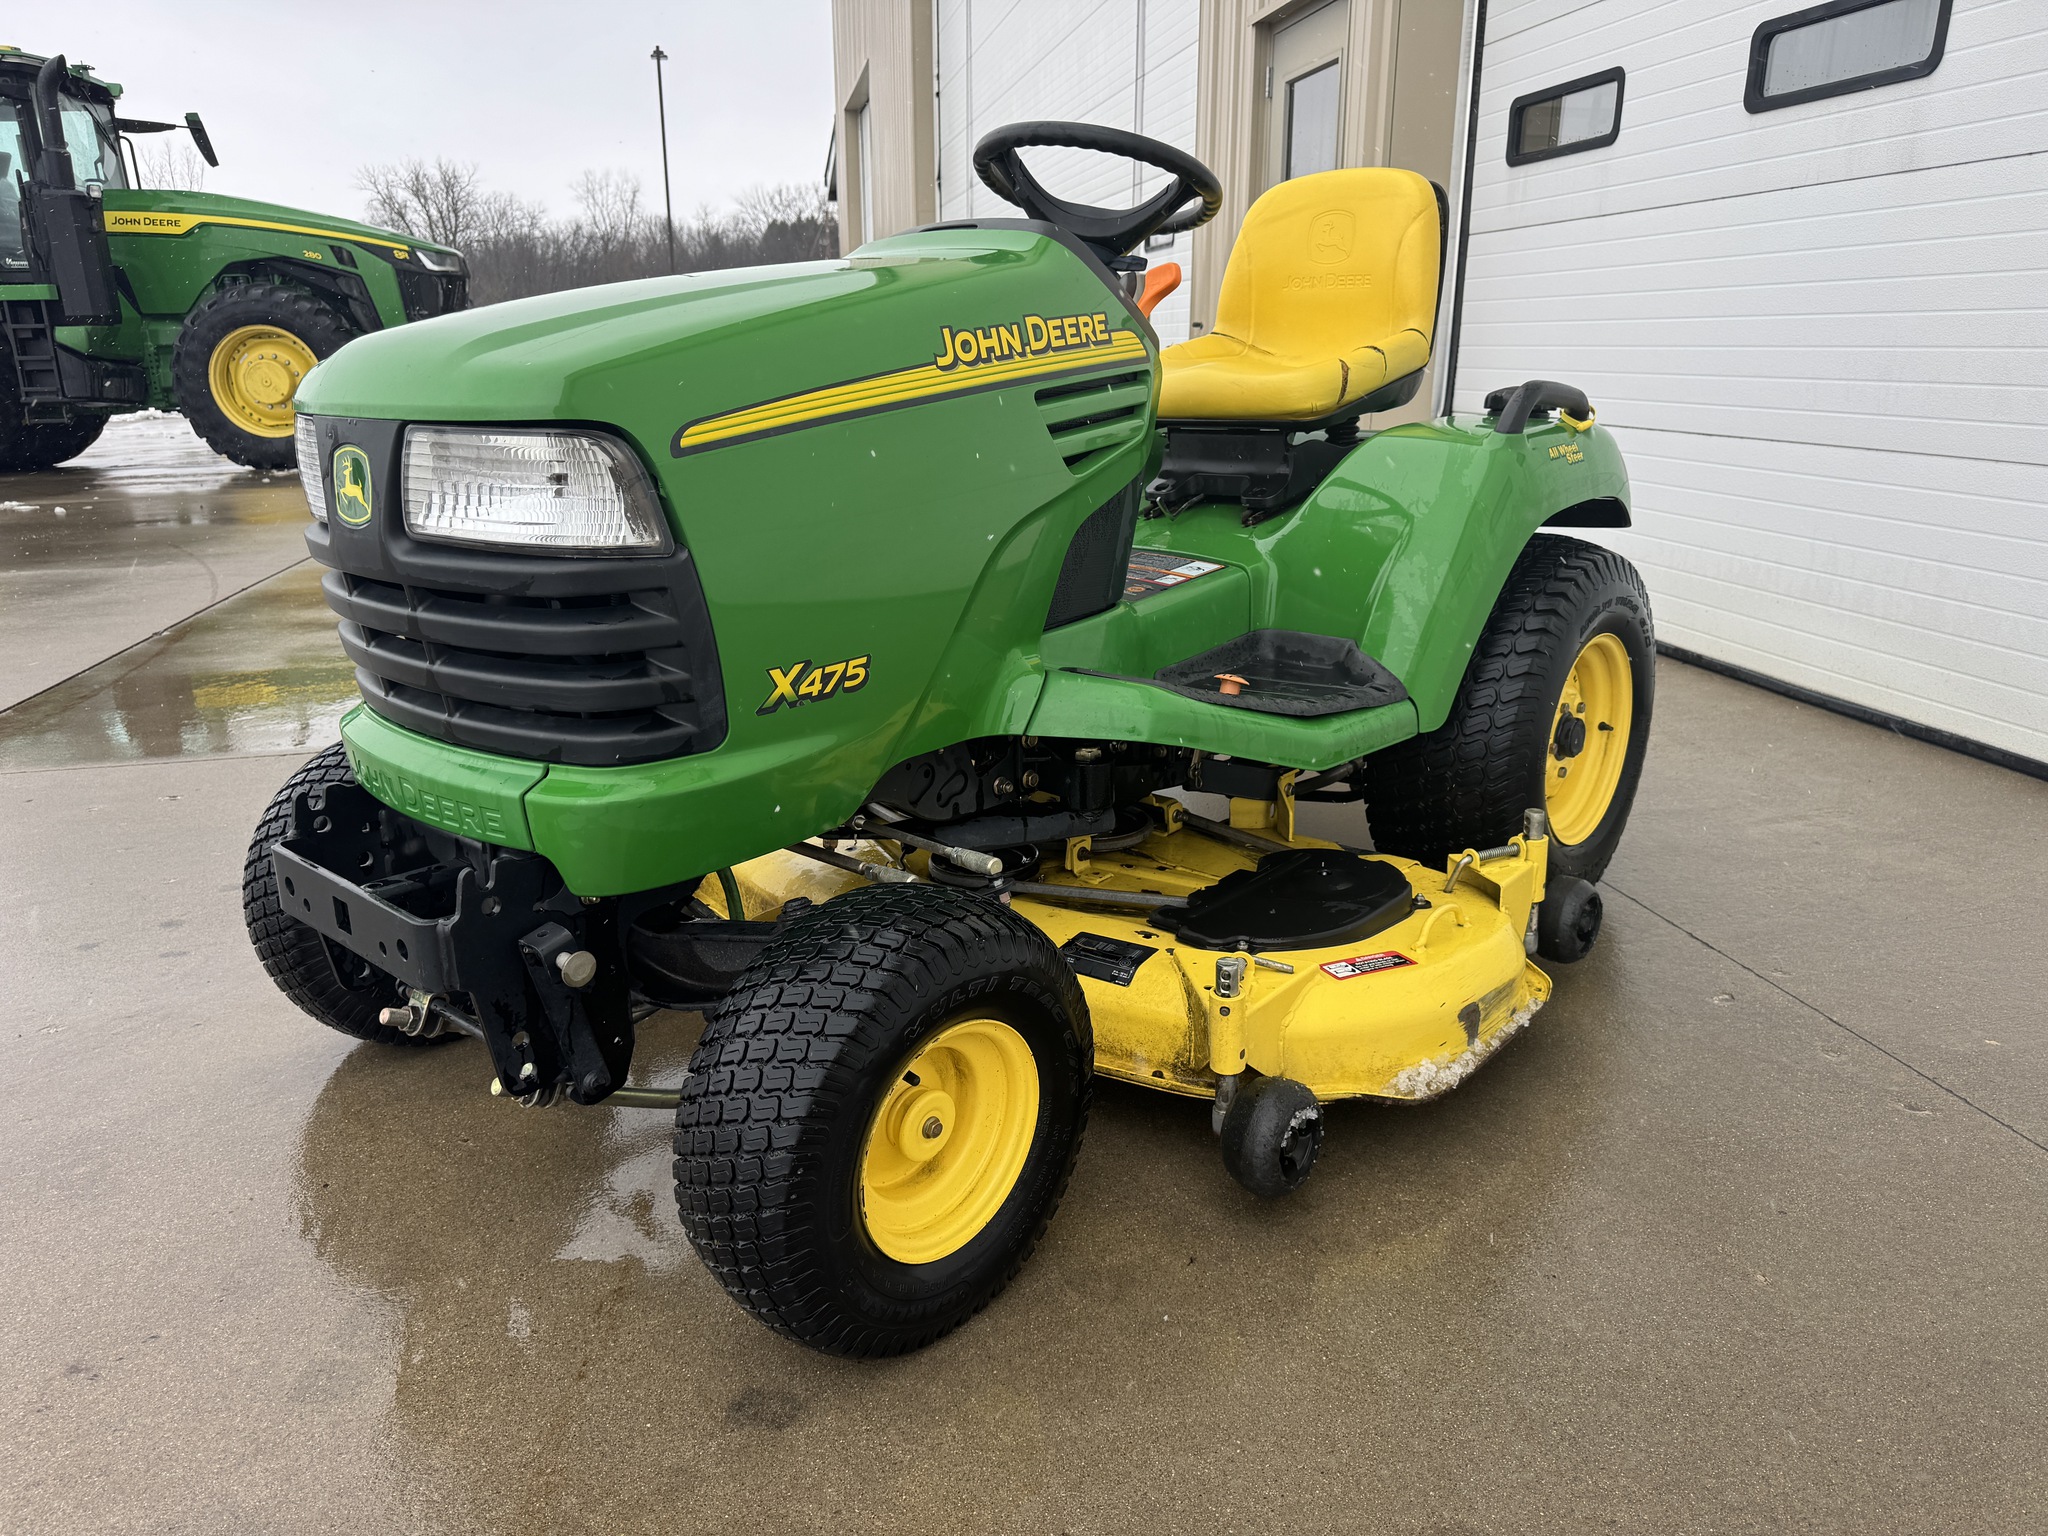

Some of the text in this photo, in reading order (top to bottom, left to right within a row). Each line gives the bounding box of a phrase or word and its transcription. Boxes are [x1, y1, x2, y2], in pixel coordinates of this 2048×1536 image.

[111, 216, 182, 228] JOHN DEERE
[303, 249, 323, 260] 280
[1282, 273, 1372, 291] JOHN DEERE
[935, 311, 1113, 372] JOHN DEERE
[1548, 441, 1579, 460] All Wheel
[1565, 452, 1584, 465] Steer
[757, 655, 870, 714] X475
[352, 750, 507, 839] JOHN DEERE
[903, 976, 999, 1048] MULTI
[1009, 976, 1067, 1024] TRAC
